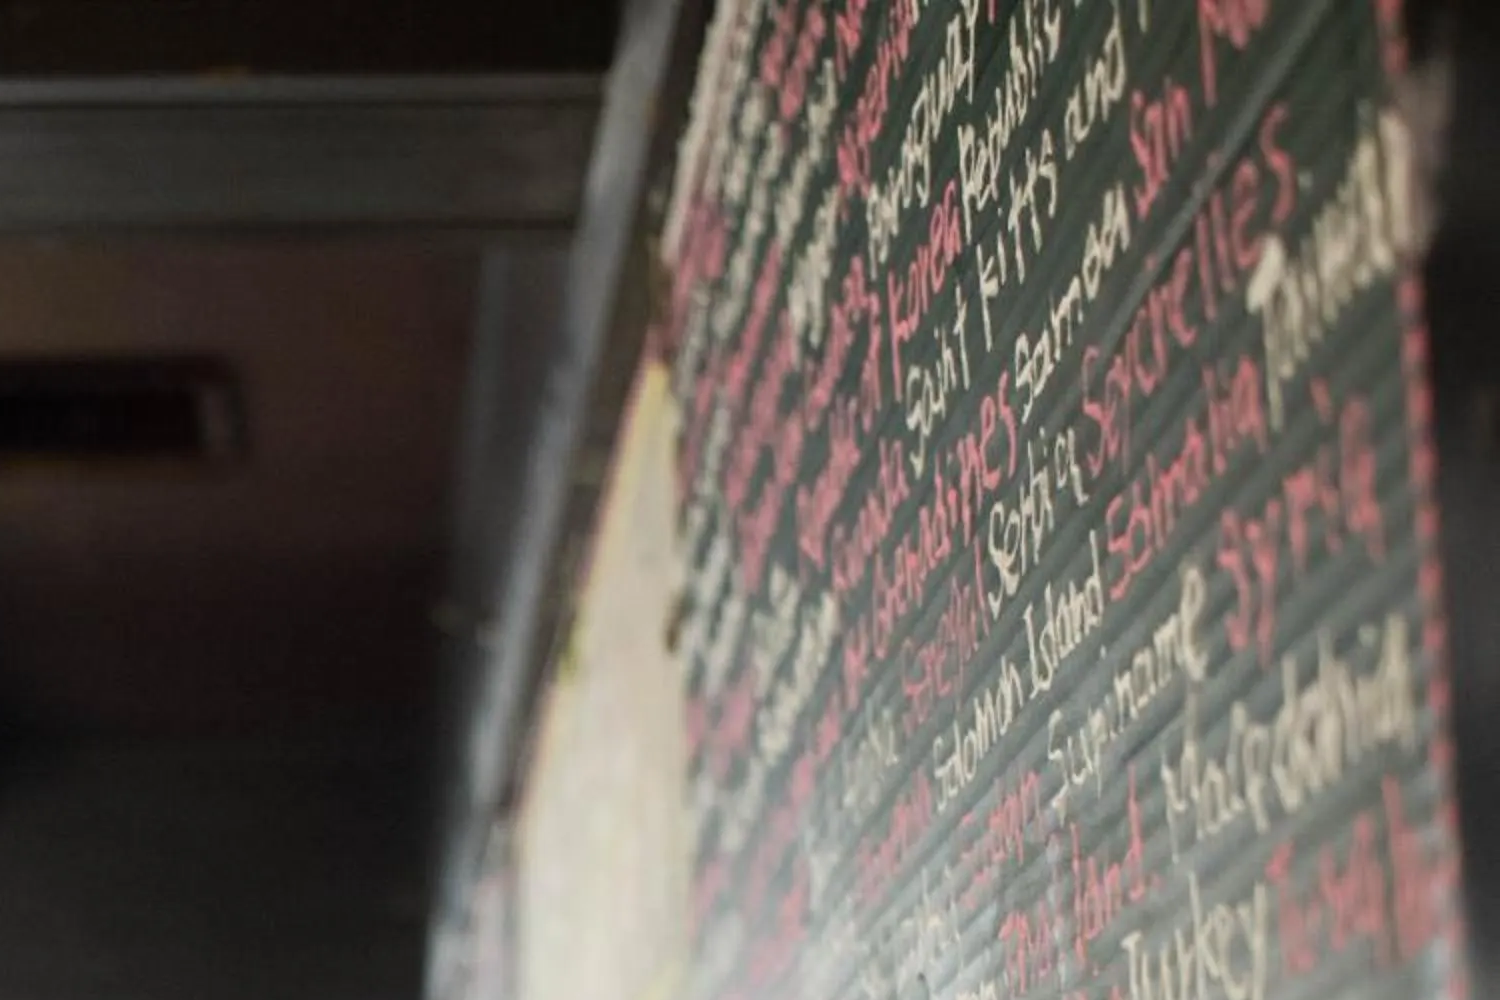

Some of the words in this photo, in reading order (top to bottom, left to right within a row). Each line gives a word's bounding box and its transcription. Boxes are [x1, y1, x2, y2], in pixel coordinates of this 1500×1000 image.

[888, 180, 961, 402] Korea
[905, 278, 970, 481] Saint
[977, 127, 1057, 352] Kitts
[1063, 0, 1126, 161] and
[1014, 182, 1131, 425] Samoa
[988, 425, 1090, 622] Serbia
[933, 652, 1023, 815] Solomon
[1023, 528, 1104, 700] Island
[1048, 553, 1208, 830] Suriname
